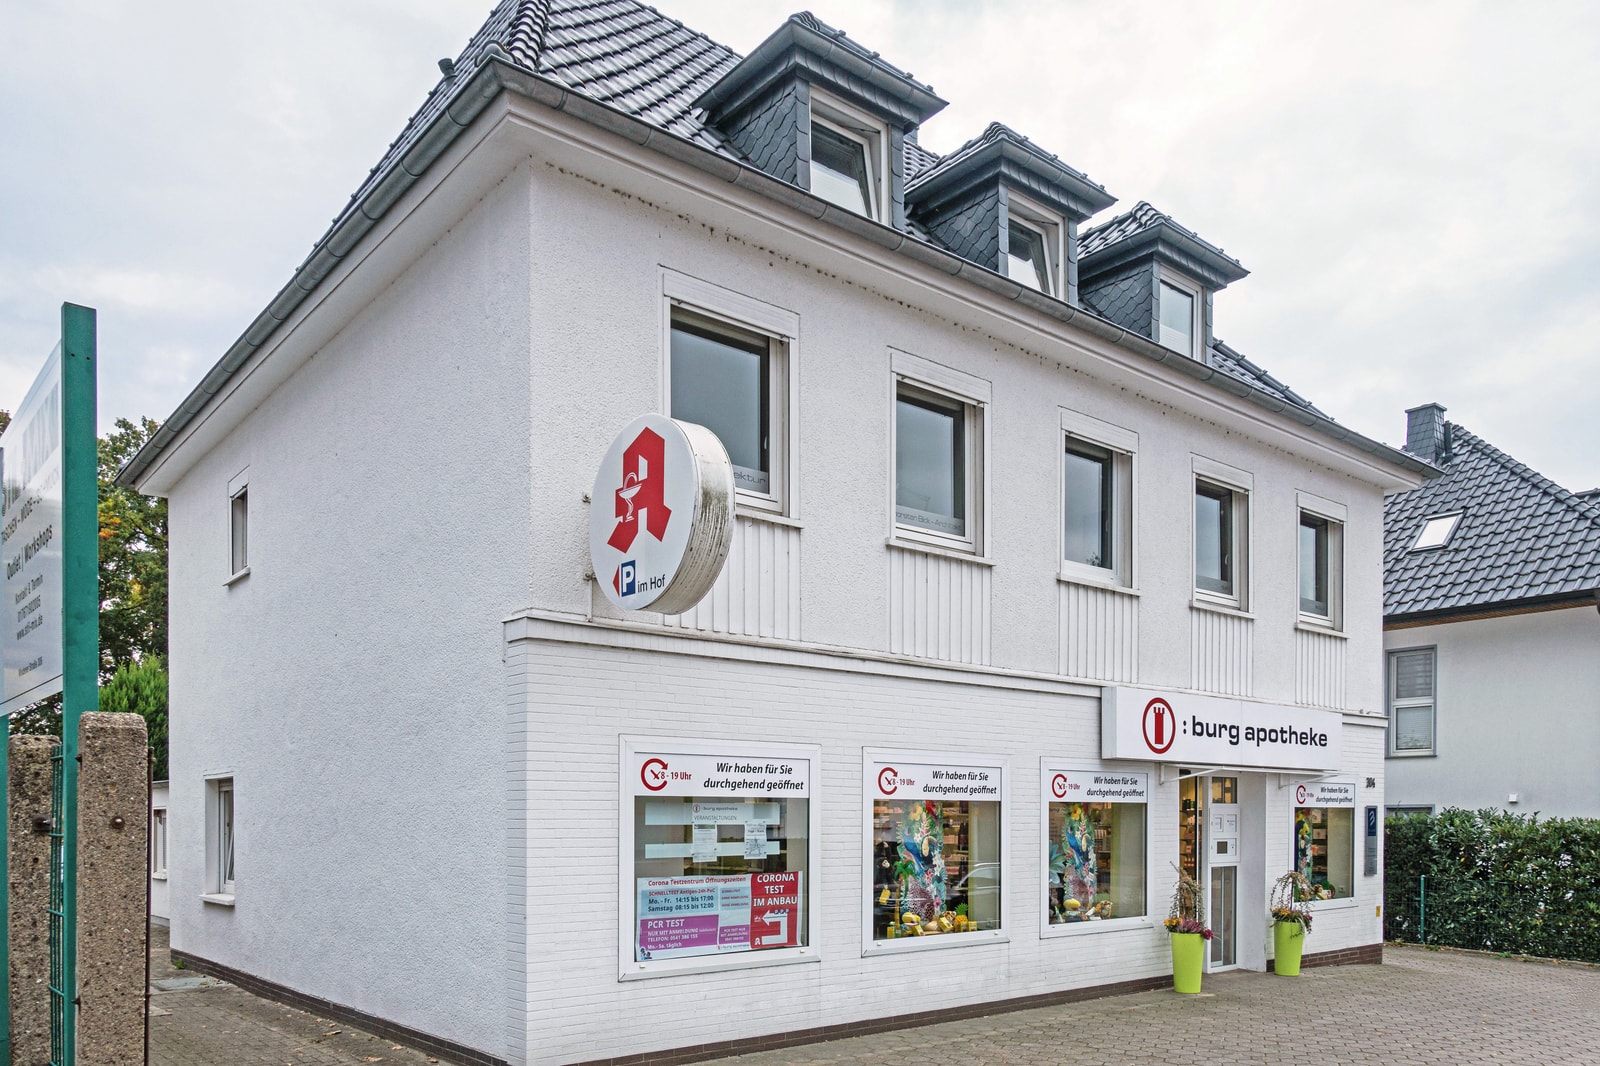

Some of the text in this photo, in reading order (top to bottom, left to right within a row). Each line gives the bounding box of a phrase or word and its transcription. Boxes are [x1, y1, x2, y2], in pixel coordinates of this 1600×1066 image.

[7, 552, 21, 580] Outlet
[24, 523, 52, 564] Workshops
[622, 565, 635, 593] P
[637, 574, 666, 593] im Hof
[1244, 725, 1328, 747] apotheke
[716, 762, 793, 776] Wir haben für Sie
[660, 771, 666, 780] 8
[671, 771, 679, 780] 19
[680, 771, 692, 781] Uhr
[932, 770, 989, 782] Wir haben für Sie
[1094, 775, 1138, 786] Wir haben für Sie
[703, 777, 804, 792] durchgehend geöffnet
[906, 778, 915, 786] Uhr
[922, 783, 997, 796] durchgehend geöffnet
[1086, 788, 1144, 798] durchgehend geöffnet
[1316, 796, 1353, 804] durchgehend geöffnet
[757, 873, 795, 883] CORONA
[764, 885, 785, 894] TEST
[753, 896, 798, 907] IM ANBAU
[647, 919, 685, 929] PCR TEST
